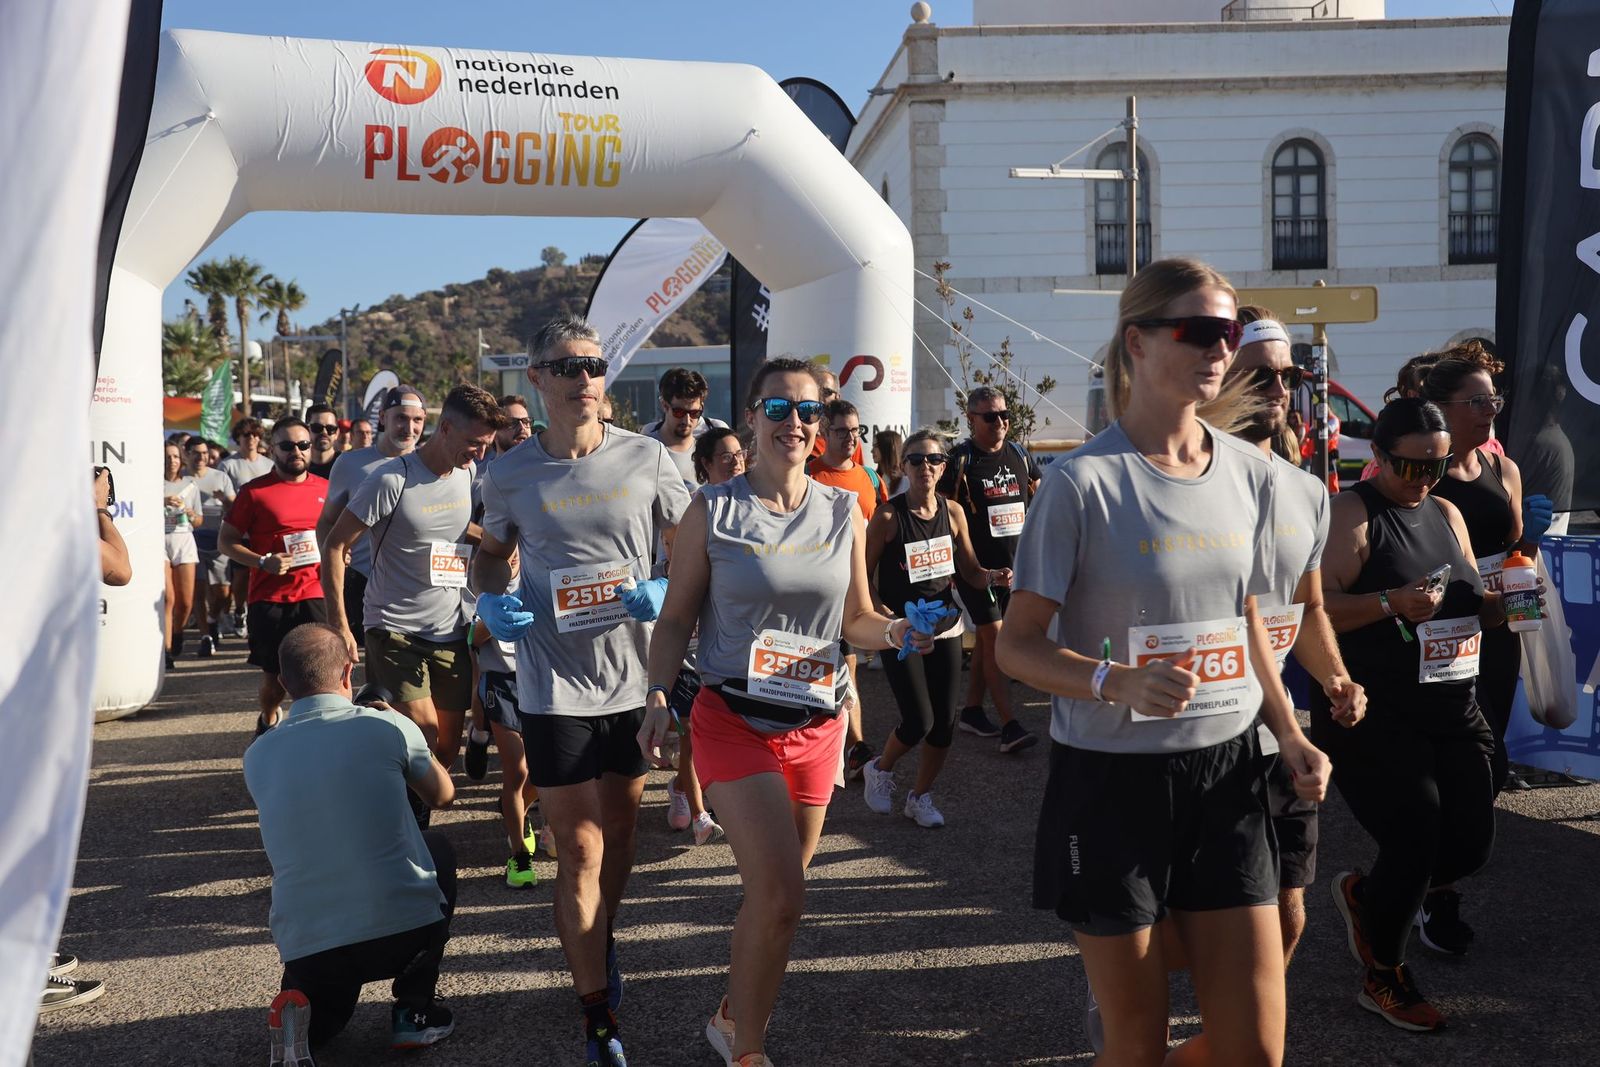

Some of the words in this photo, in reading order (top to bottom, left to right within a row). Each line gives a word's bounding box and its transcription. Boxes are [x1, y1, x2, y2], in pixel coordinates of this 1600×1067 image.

[455, 58, 575, 76] nationale
[458, 76, 619, 100] nederlanden
[558, 112, 620, 133] TOUR
[364, 124, 622, 188] PLOGGING
[432, 557, 465, 570] 25746
[914, 550, 948, 567] 25166
[566, 583, 617, 606] 2519
[1429, 637, 1476, 657] 25770
[761, 653, 825, 682] 25194
[1069, 834, 1080, 874] FUSION
